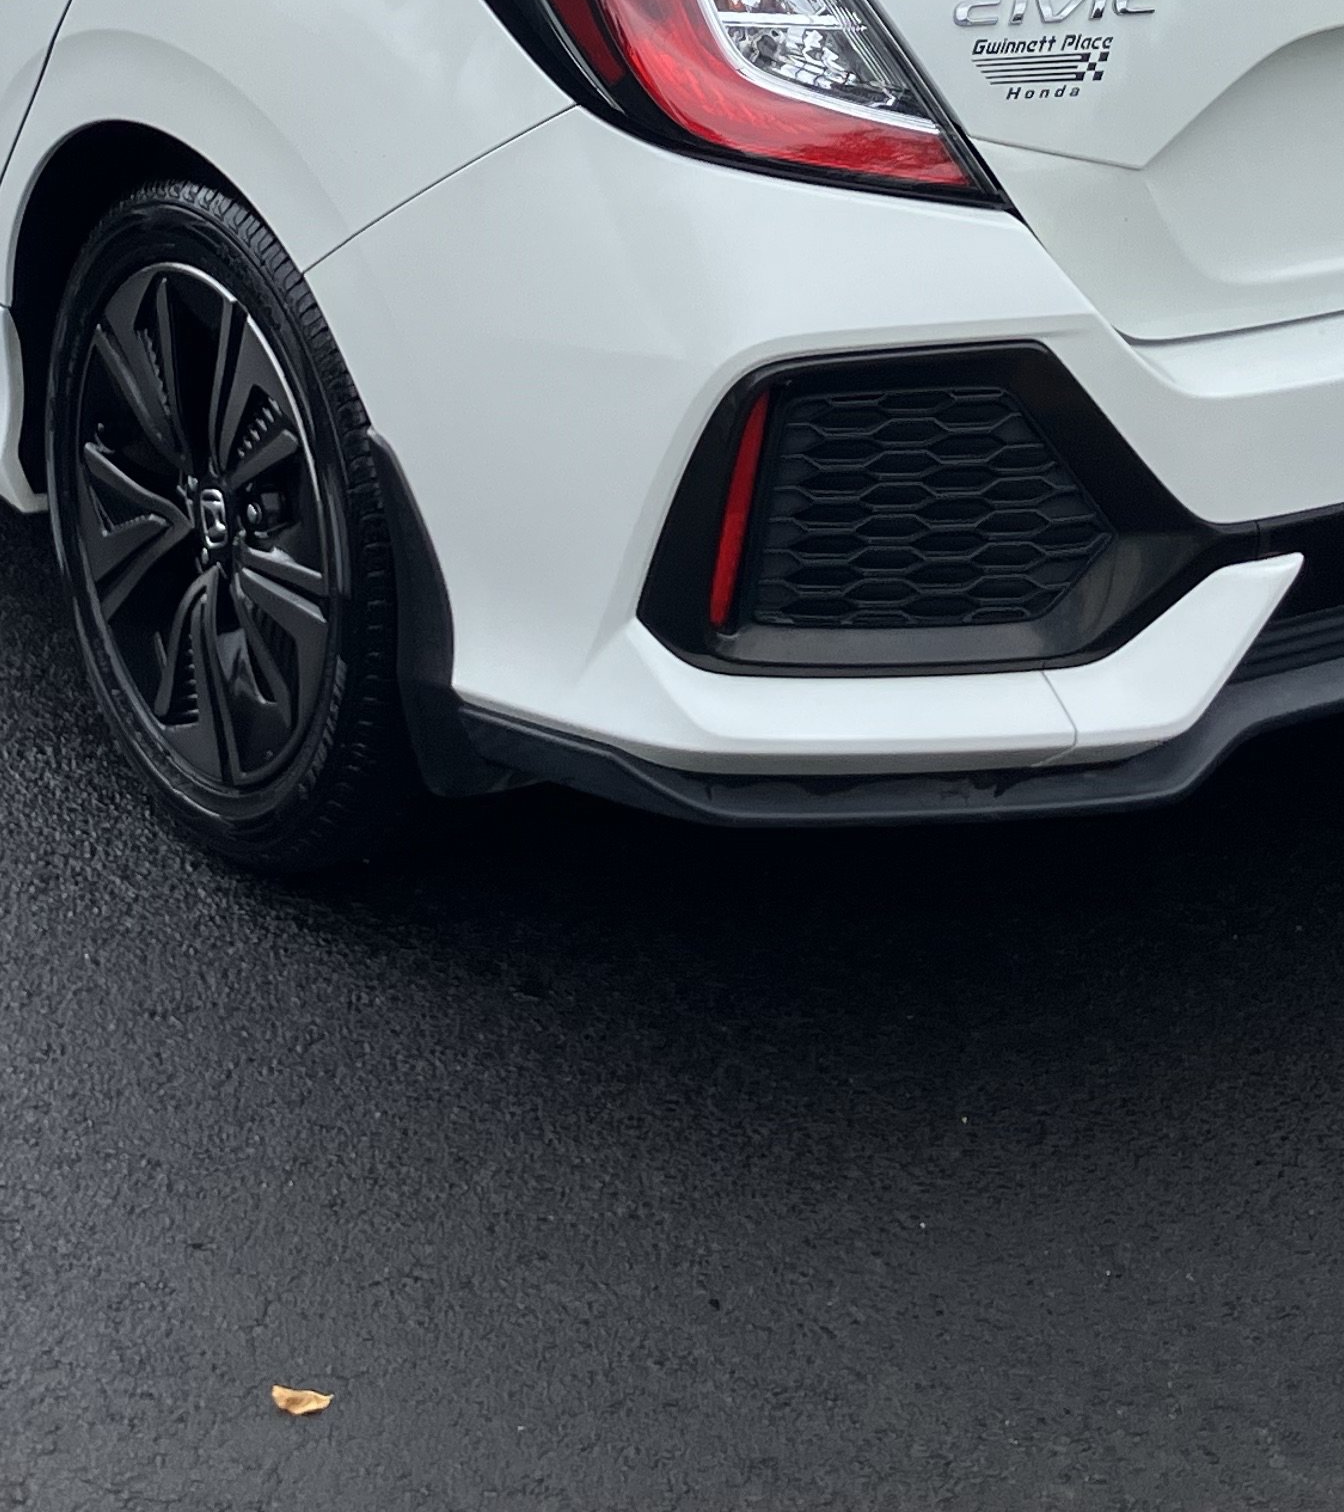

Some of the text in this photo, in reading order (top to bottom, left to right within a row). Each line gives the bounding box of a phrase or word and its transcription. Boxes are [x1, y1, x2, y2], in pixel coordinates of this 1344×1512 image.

[972, 33, 1114, 55] Gwinnett Place
[1006, 85, 1080, 100] Honda
